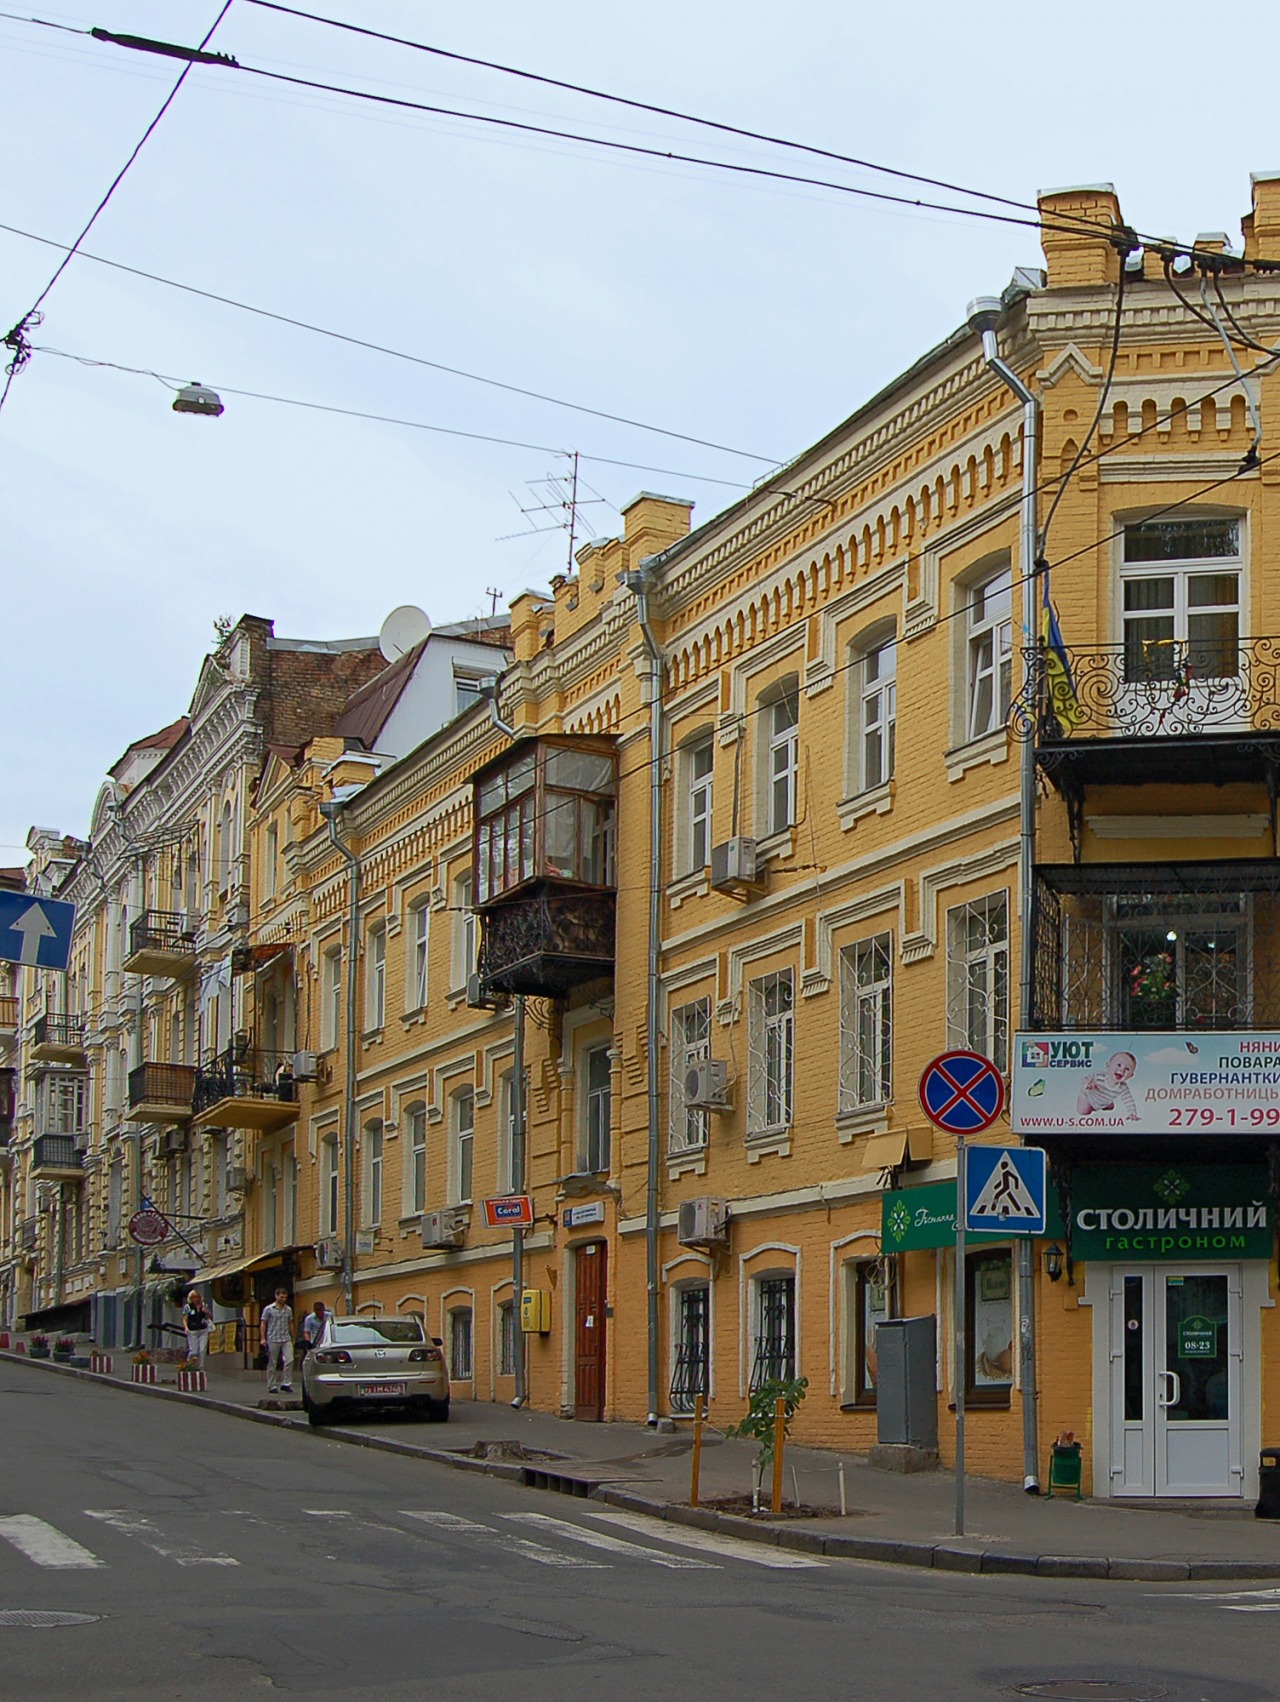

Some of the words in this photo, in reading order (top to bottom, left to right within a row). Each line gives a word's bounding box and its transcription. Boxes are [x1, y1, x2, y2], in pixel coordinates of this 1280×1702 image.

[1049, 1041, 1094, 1059] УЮТ
[1049, 1059, 1093, 1069] СЕРВИС
[1020, 1117, 1125, 1127] WWW.U-S.COM.UA
[497, 1205, 520, 1214] Coral
[1076, 1201, 1268, 1230] СТОЛИЧНИЙ
[1105, 1233, 1247, 1253] гастроном
